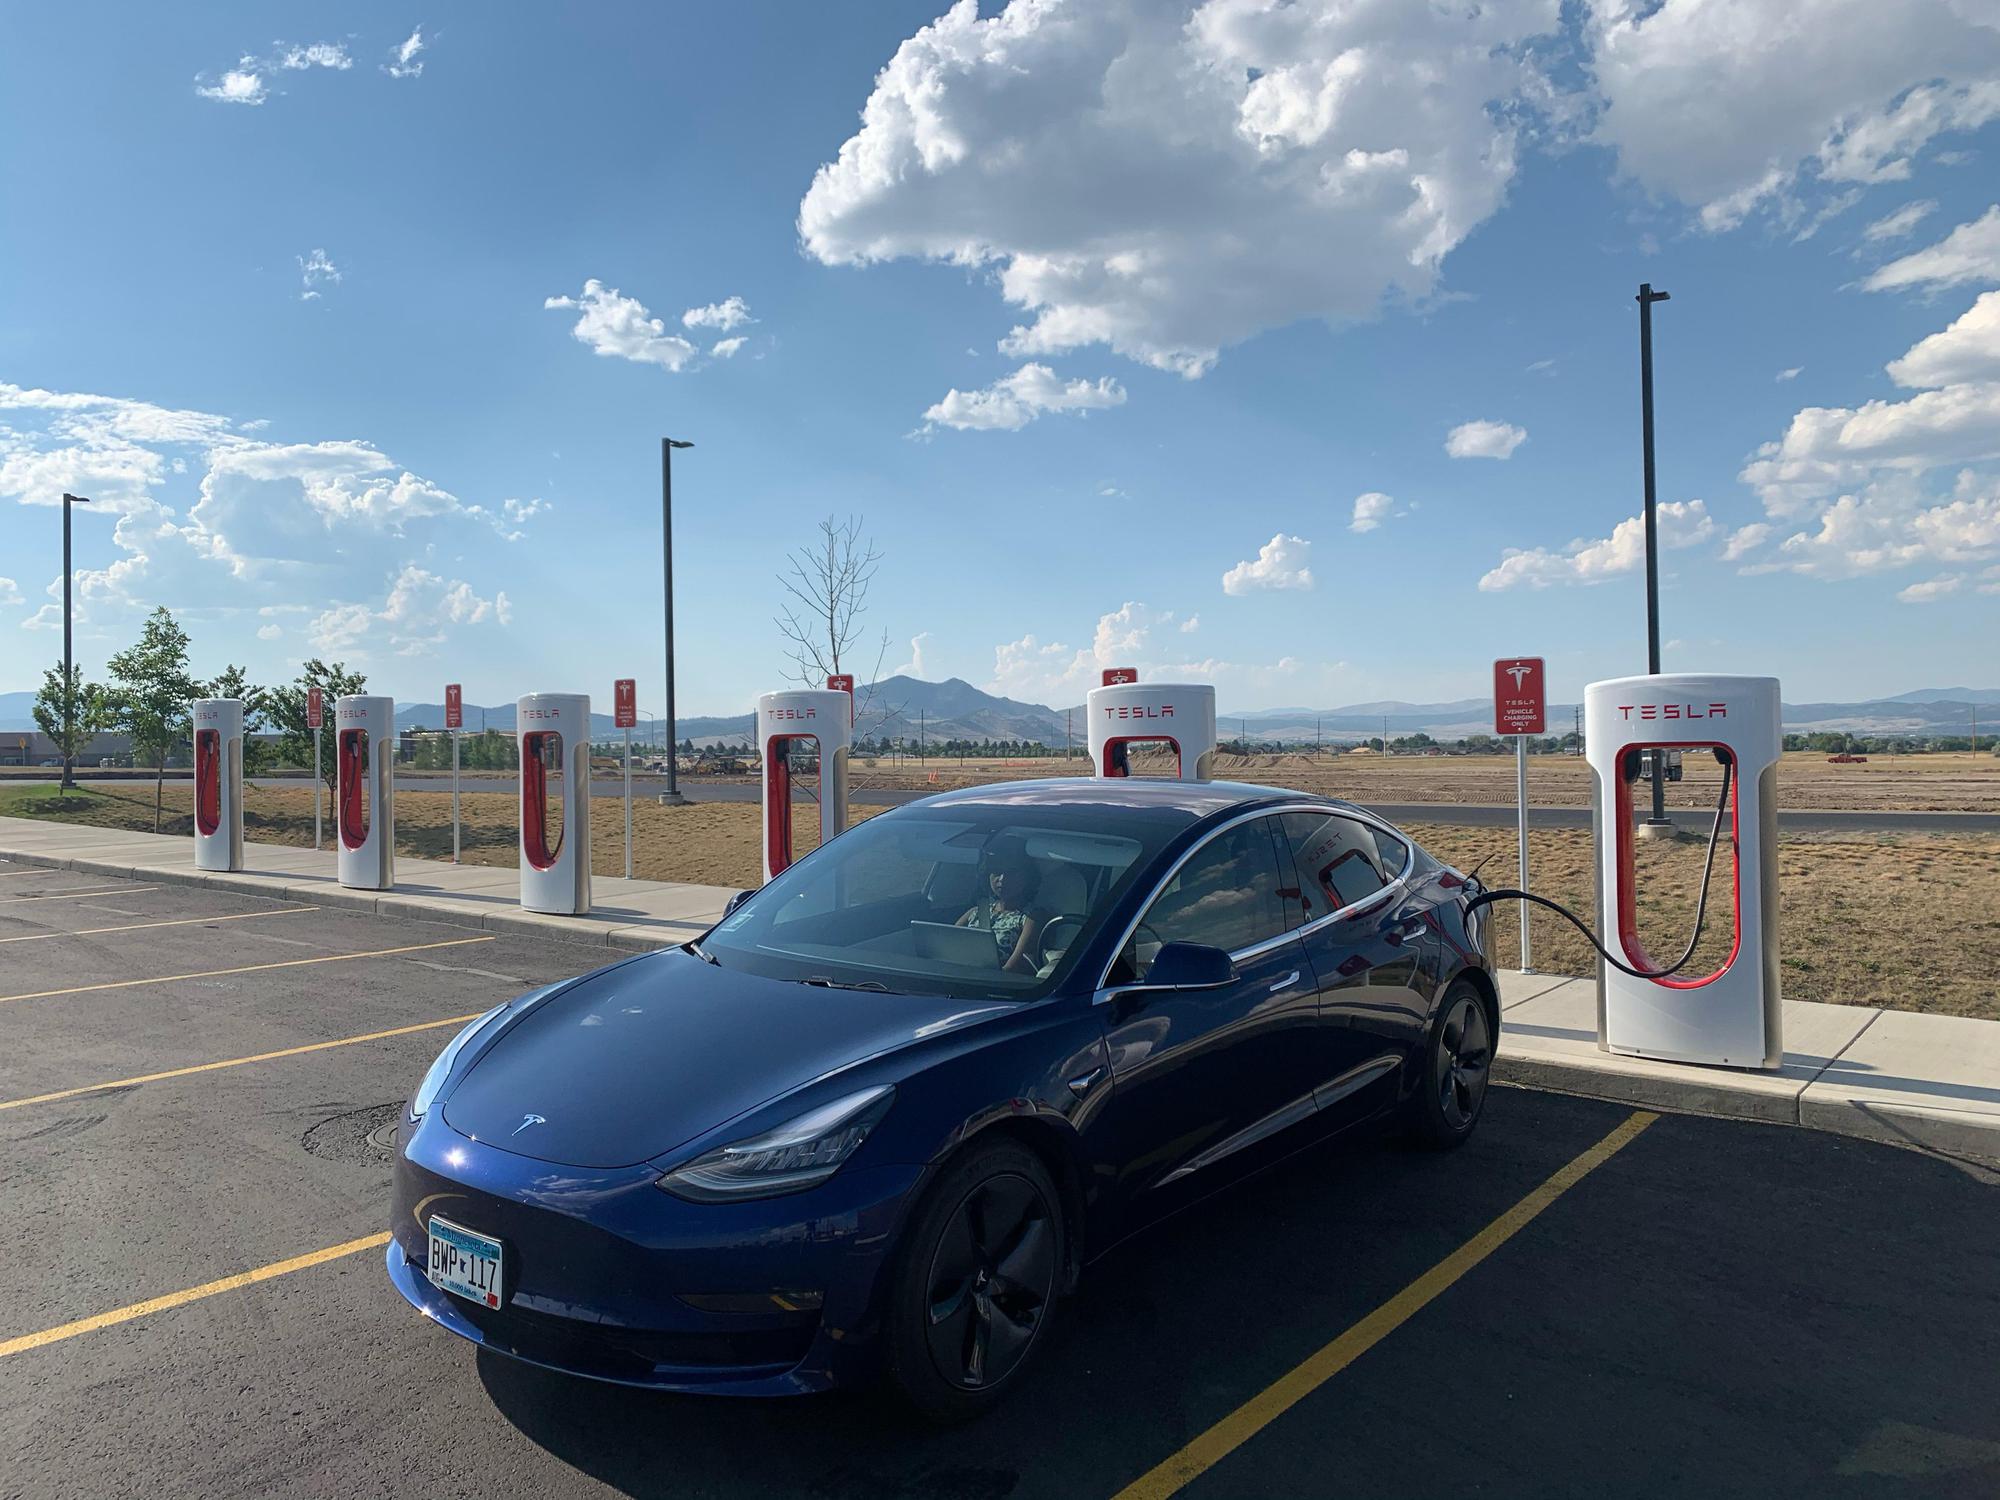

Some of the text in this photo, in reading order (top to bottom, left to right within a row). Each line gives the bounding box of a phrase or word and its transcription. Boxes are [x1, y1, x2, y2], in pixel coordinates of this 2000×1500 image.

[339, 709, 367, 718] TESLA
[522, 709, 560, 719] TESLA
[768, 708, 816, 720] TESLA
[1104, 705, 1174, 719] TESLA
[1617, 703, 1727, 720] TESLA
[432, 1238, 497, 1293] BWP 117
